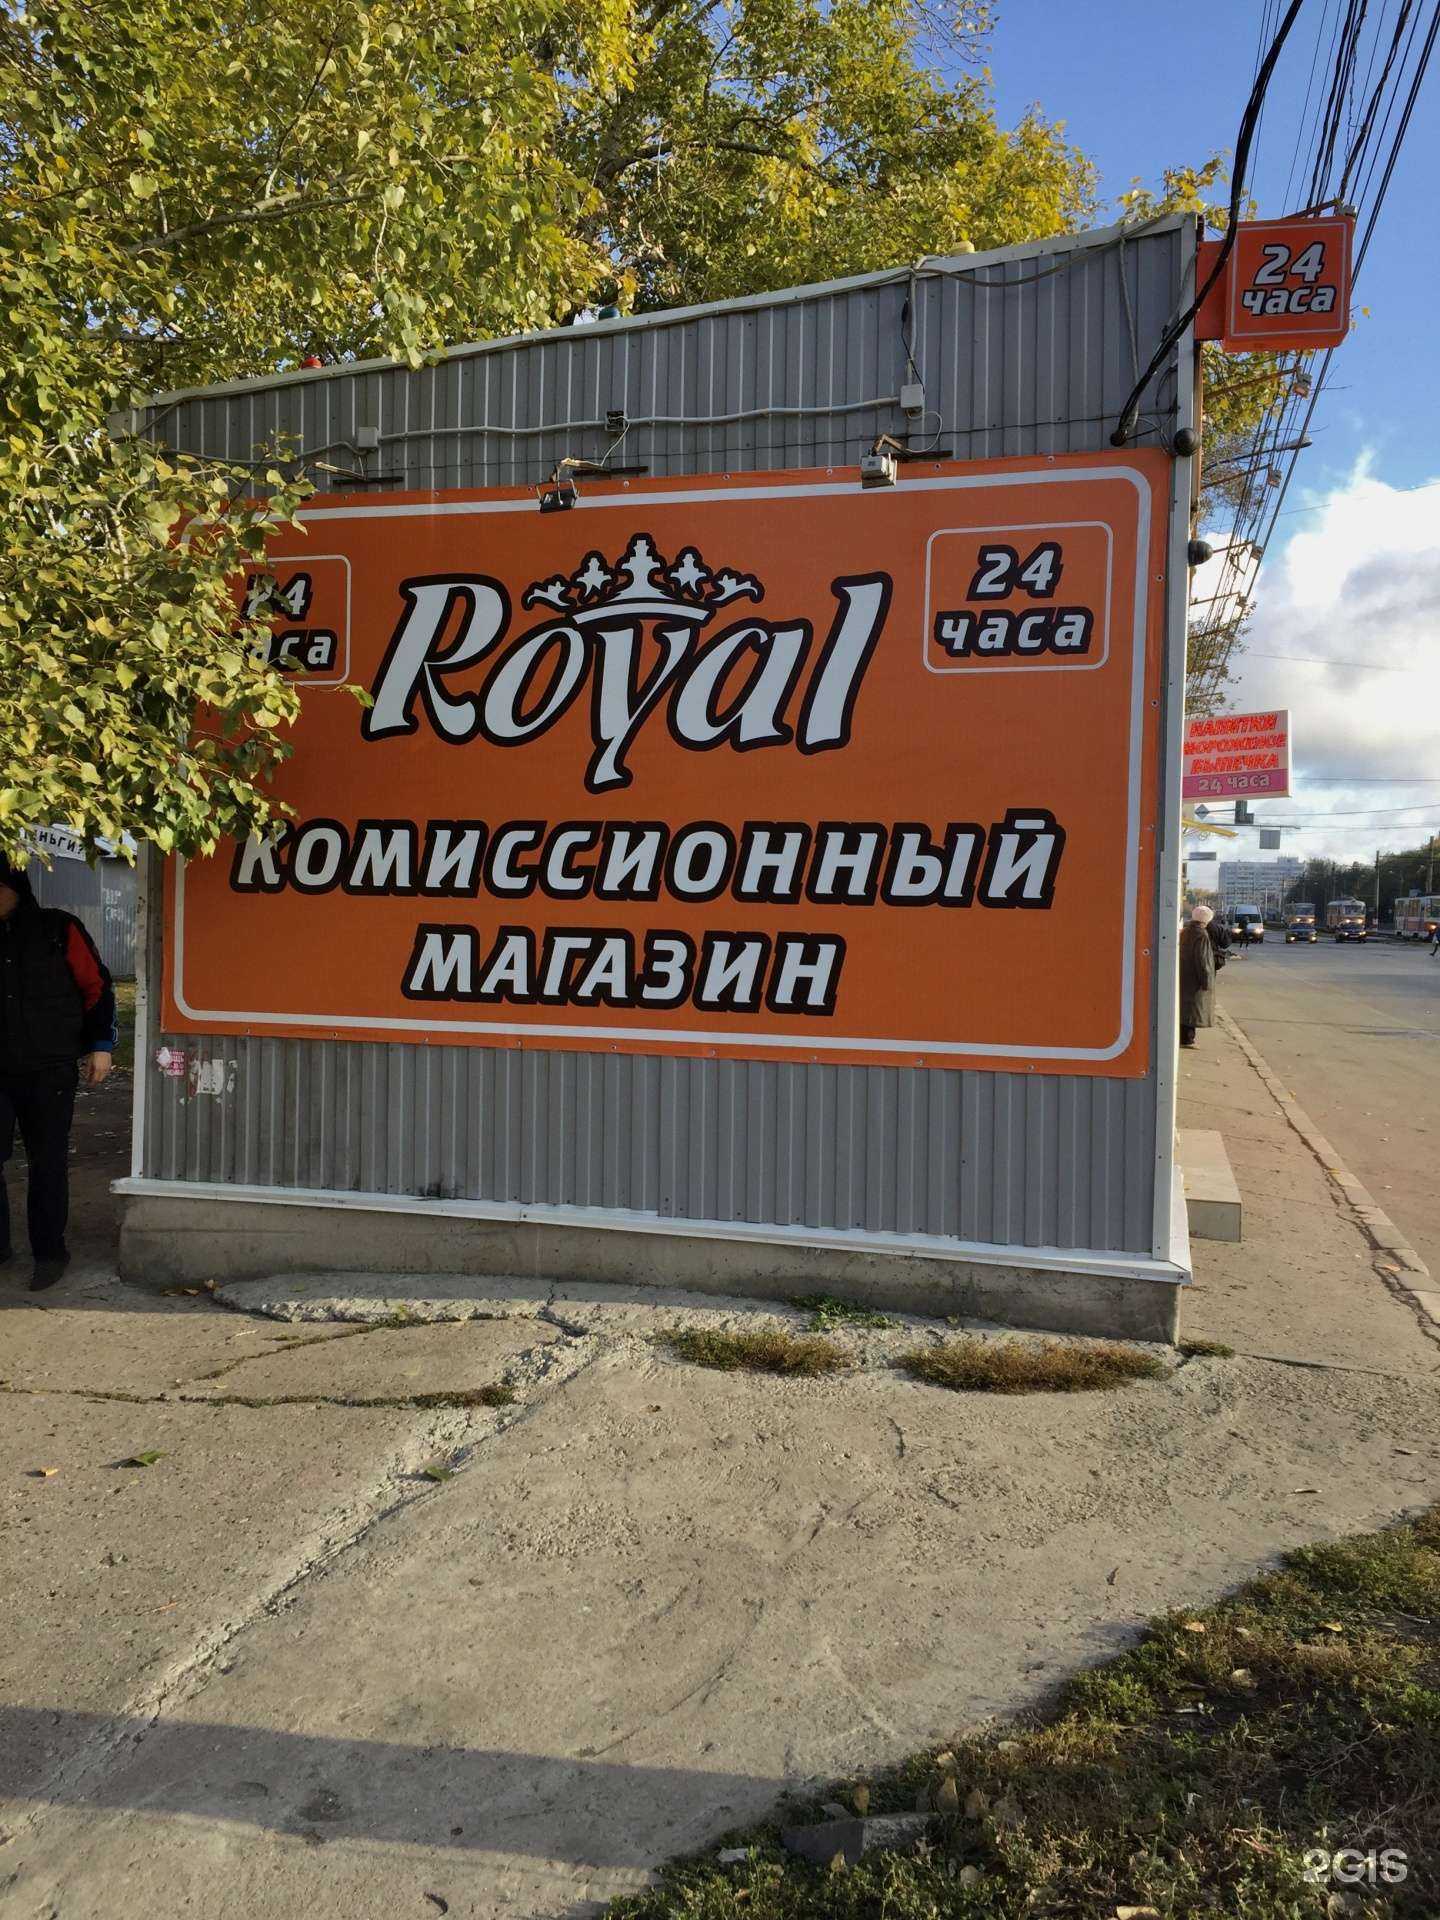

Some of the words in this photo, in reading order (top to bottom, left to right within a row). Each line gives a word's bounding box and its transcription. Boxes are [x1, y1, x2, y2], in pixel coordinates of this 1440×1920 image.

[1254, 242, 1325, 286] 24
[1243, 287, 1336, 316] часа
[971, 546, 1059, 597] 24
[244, 631, 335, 669] аса
[938, 611, 1090, 653] часа
[365, 577, 887, 789] Royal
[1199, 779, 1222, 793] 24
[1227, 774, 1270, 788] часа
[25, 828, 84, 854] НЬГИ?
[233, 812, 1061, 904] КОМИССИОННЫЙ
[406, 927, 841, 1012] МАГАЗИН
